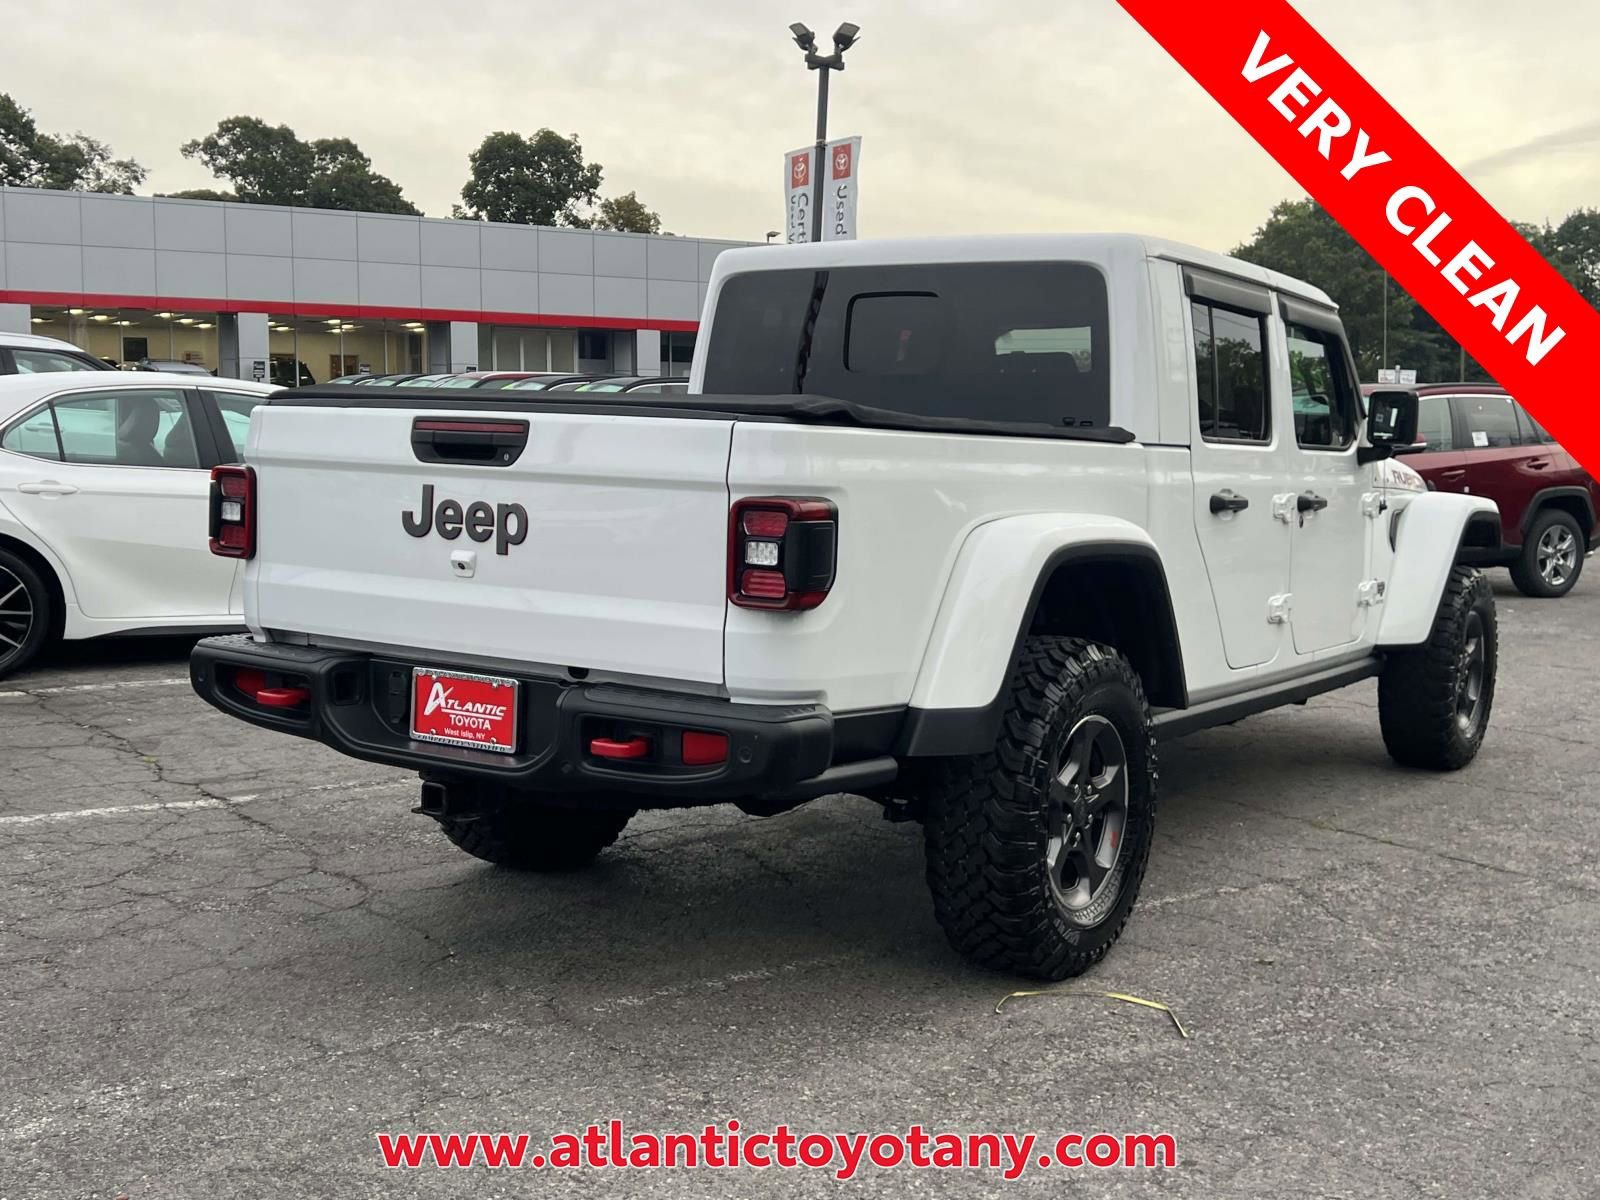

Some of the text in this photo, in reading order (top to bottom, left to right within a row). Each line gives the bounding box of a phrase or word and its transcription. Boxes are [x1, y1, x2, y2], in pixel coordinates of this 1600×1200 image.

[835, 184, 847, 235] Used
[401, 483, 529, 556] Jeep
[423, 681, 507, 717] ATLANTIC
[444, 727, 460, 737] West
[475, 732, 486, 740] NY
[449, 714, 491, 731] TOYOTA
